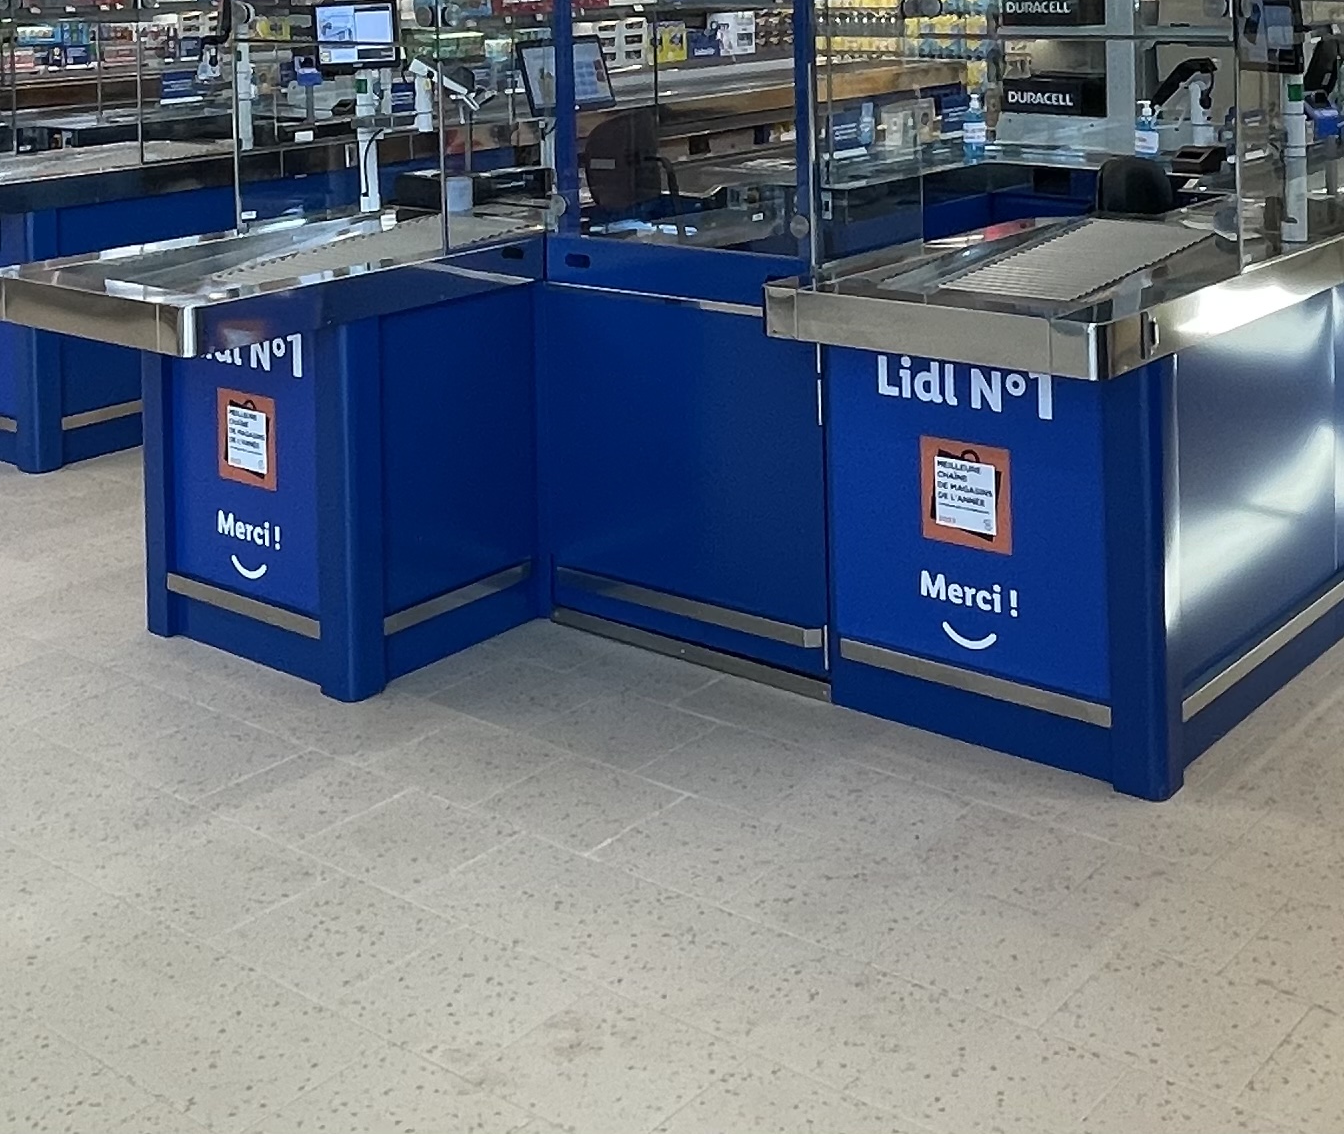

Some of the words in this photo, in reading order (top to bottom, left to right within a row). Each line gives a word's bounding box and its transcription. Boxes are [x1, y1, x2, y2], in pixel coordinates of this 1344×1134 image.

[1006, 1, 1072, 14] DURACELL
[1008, 91, 1074, 106] DURACELL
[250, 333, 303, 378] N°1
[877, 355, 958, 406] Lidl
[970, 368, 1053, 420] N°1
[937, 480, 948, 489] DE
[950, 483, 993, 497] MAGASINS
[938, 491, 948, 500] DE
[217, 509, 270, 548] Merci
[920, 570, 1002, 613] Merci
